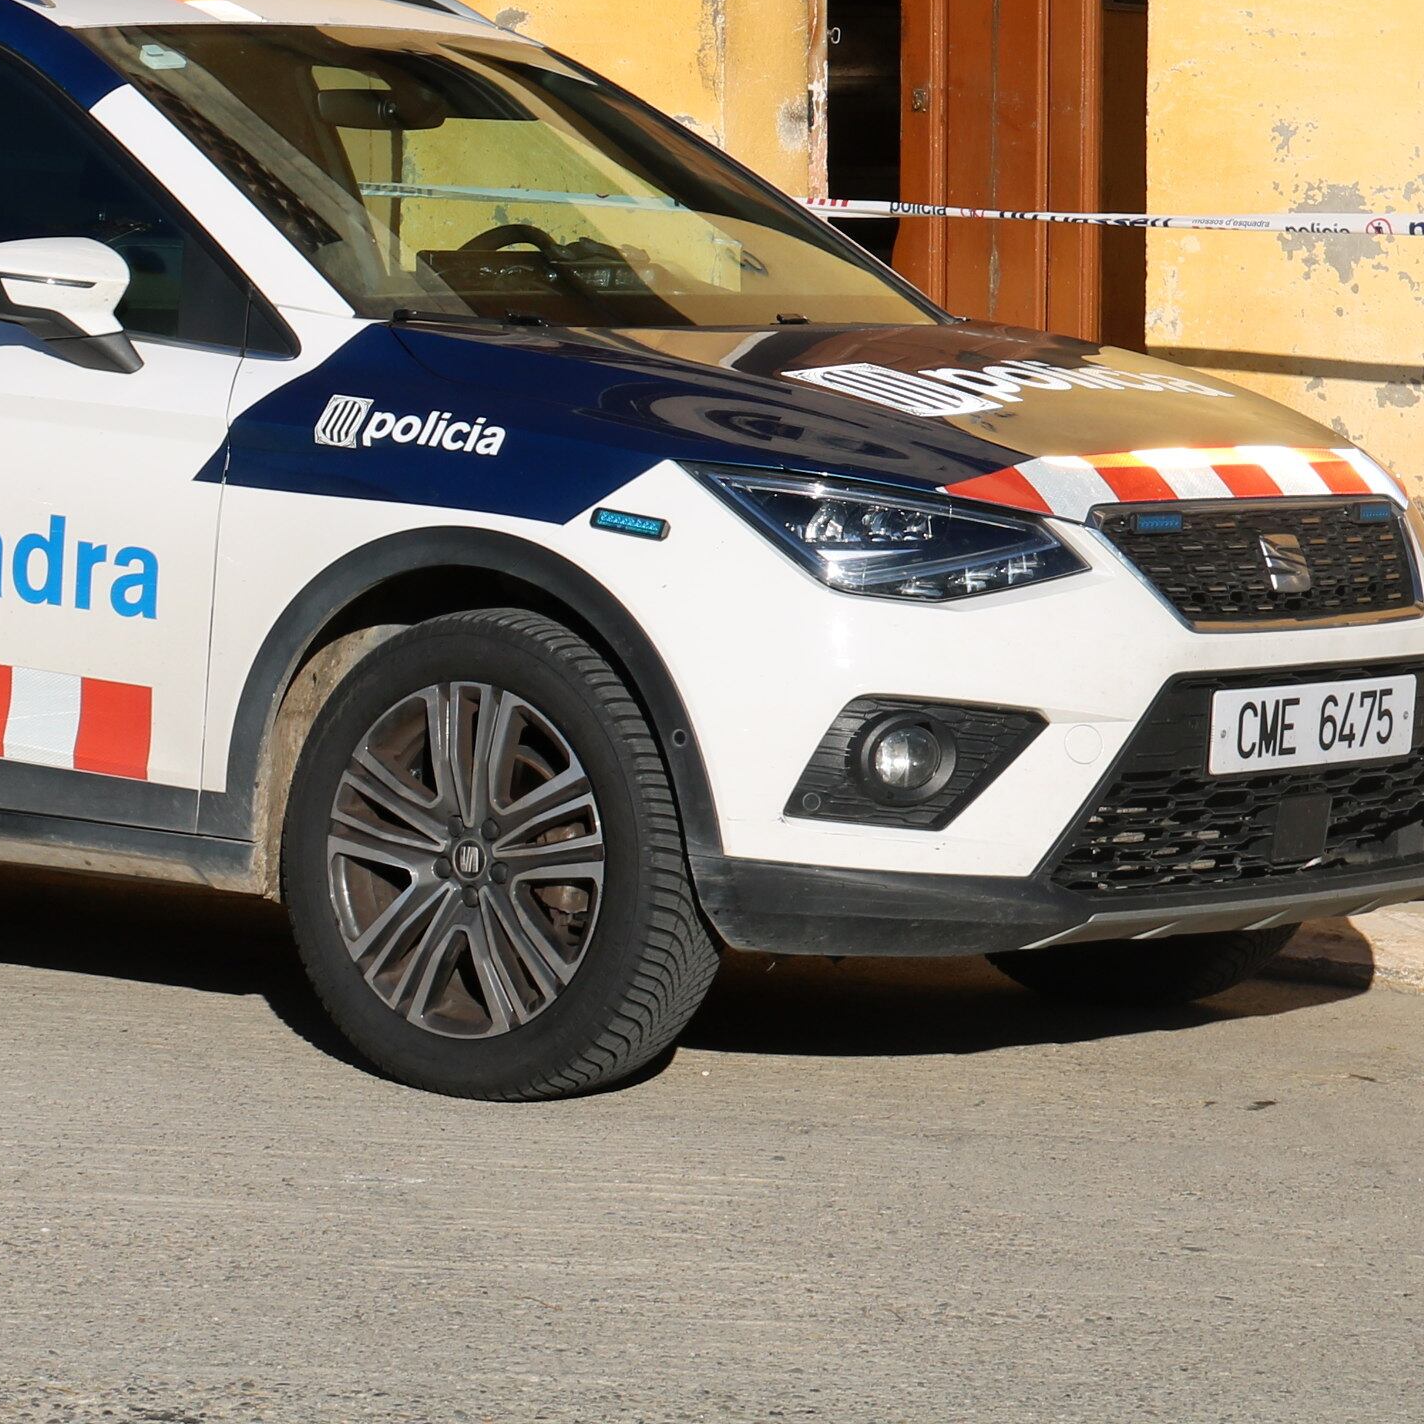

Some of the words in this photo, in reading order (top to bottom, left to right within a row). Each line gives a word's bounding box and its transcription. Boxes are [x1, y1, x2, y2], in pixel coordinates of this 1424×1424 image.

[918, 359, 1236, 403] policia
[361, 409, 506, 456] policia
[1237, 697, 1301, 759] CME
[1318, 688, 1394, 751] 6475
